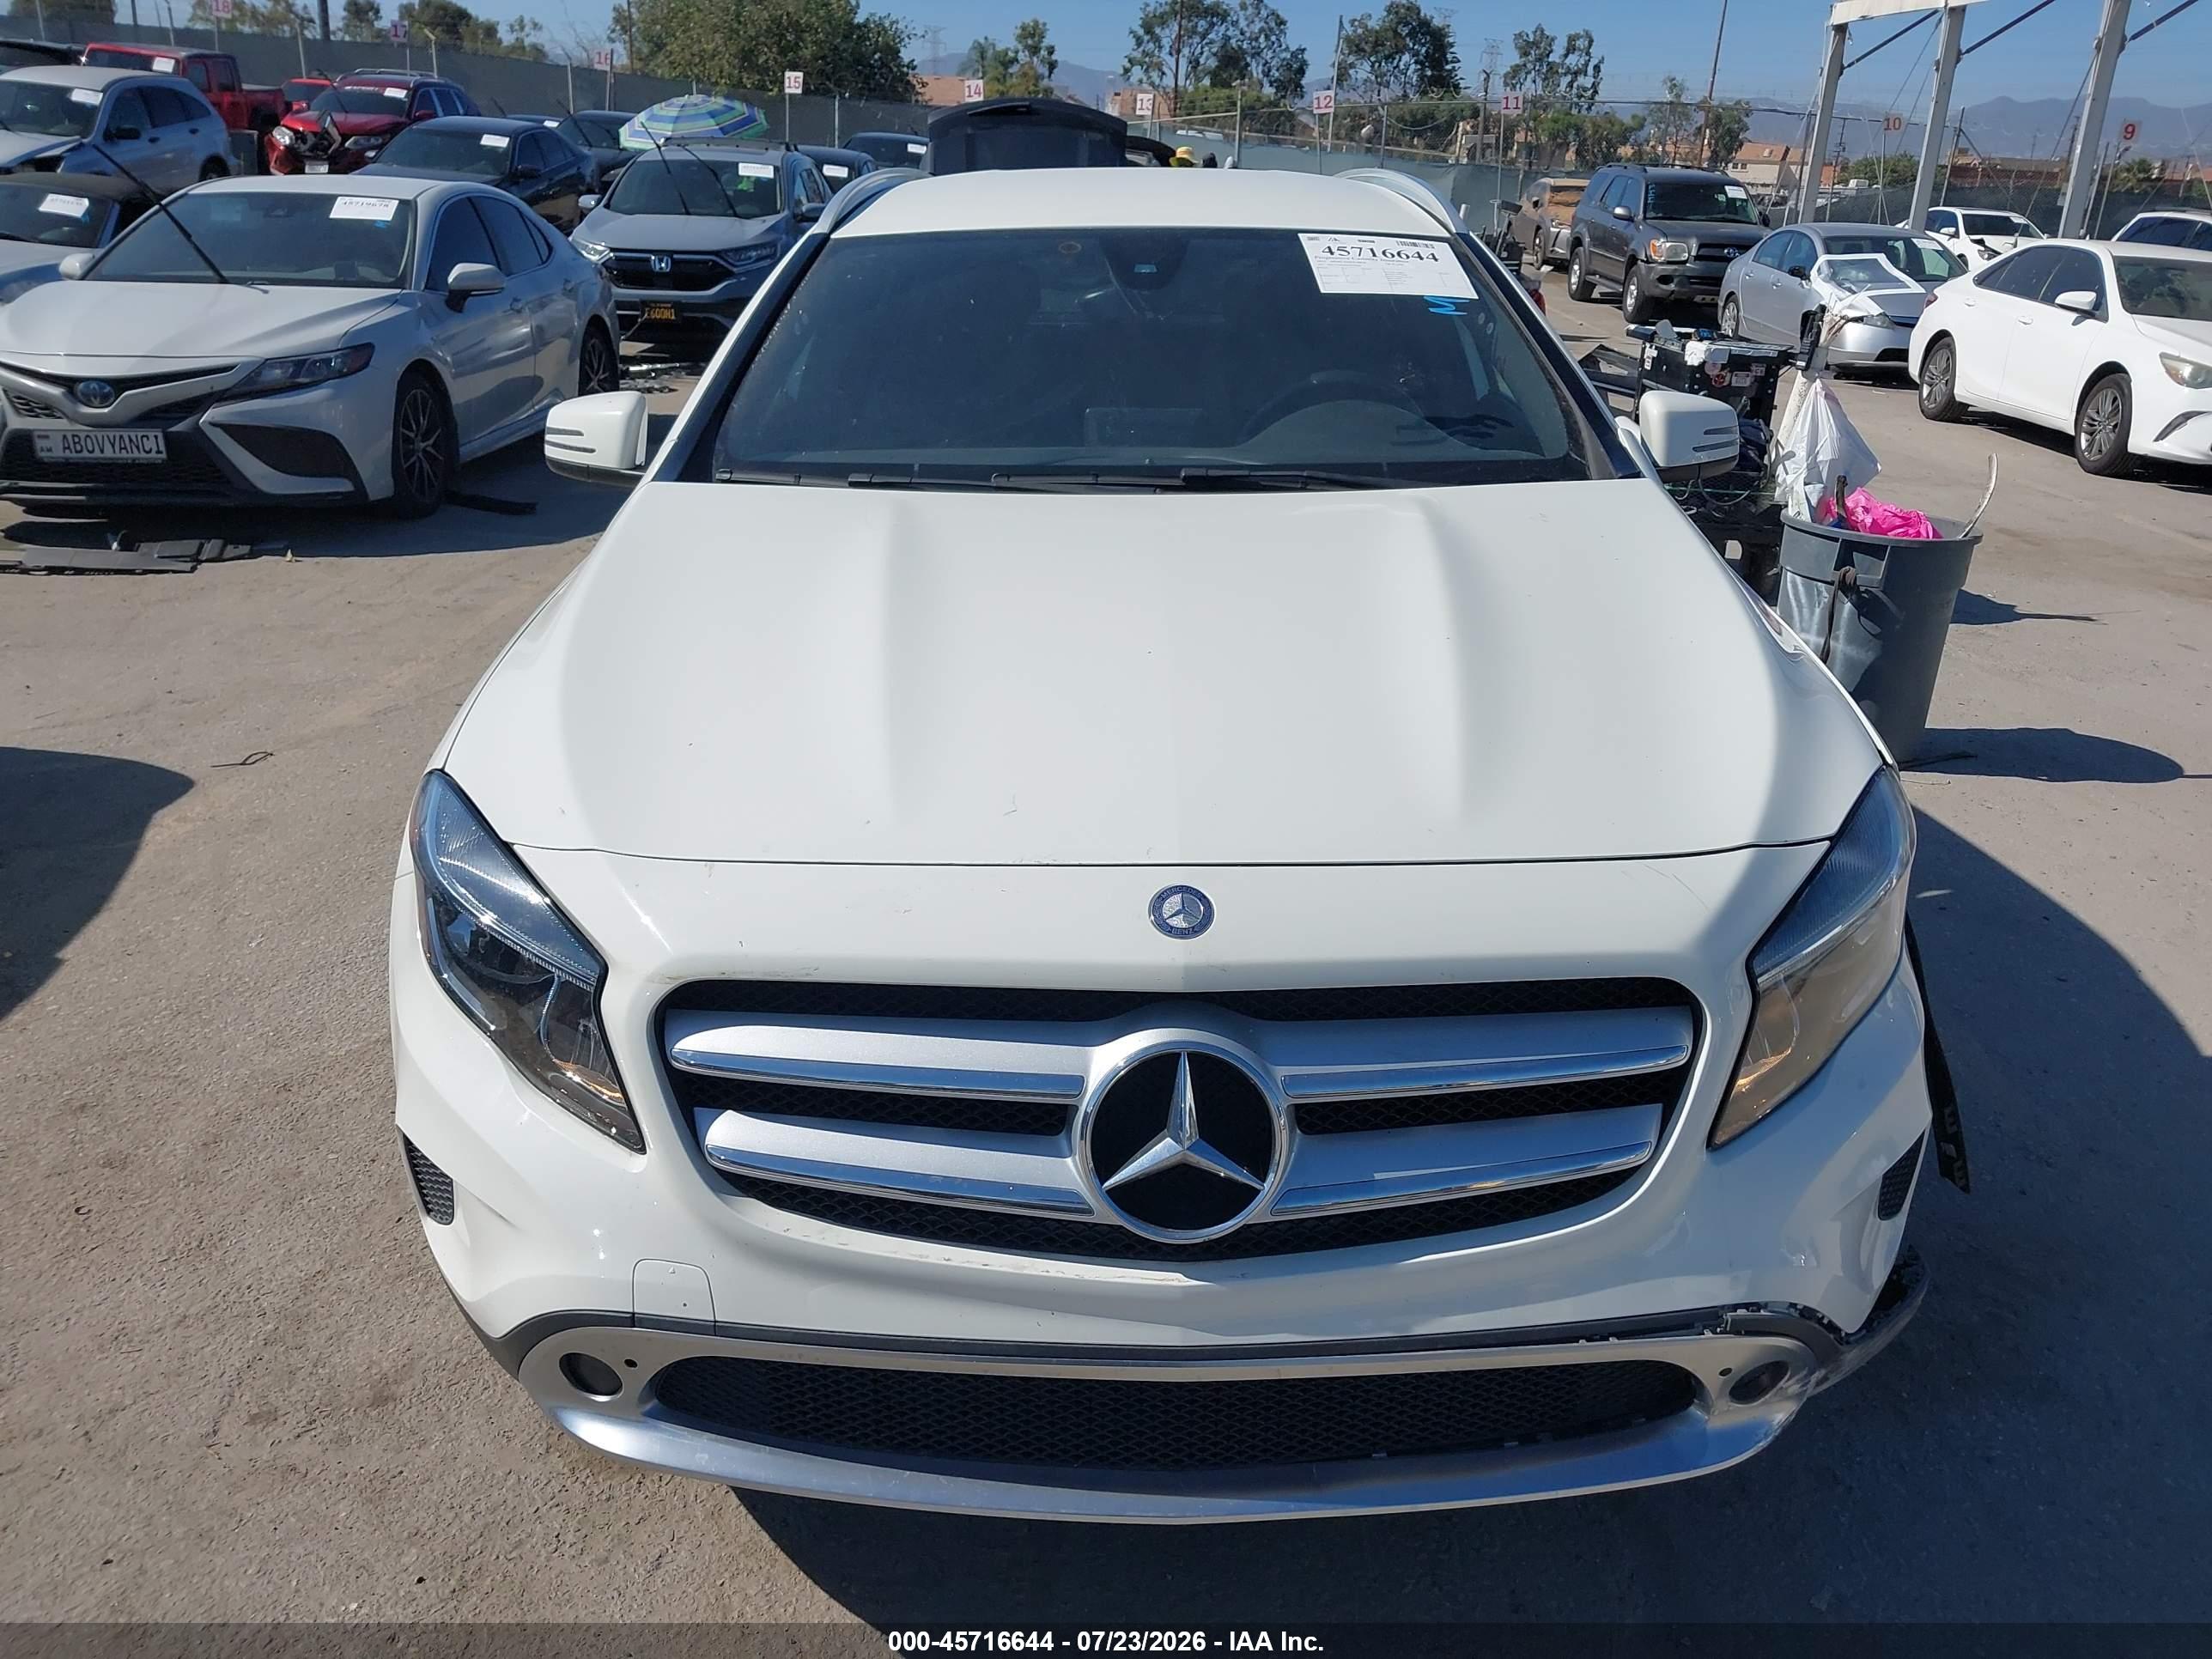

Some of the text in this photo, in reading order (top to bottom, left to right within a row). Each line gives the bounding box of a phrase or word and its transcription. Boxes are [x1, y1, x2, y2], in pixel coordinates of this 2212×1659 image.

[392, 24, 407, 39] 17
[786, 76, 801, 89] 15
[966, 83, 983, 98] 14
[1314, 94, 1334, 110] 12
[1502, 95, 1522, 110] 11
[1883, 117, 1902, 131] 10
[2123, 123, 2136, 141] 9
[1321, 245, 1439, 263] 45716644
